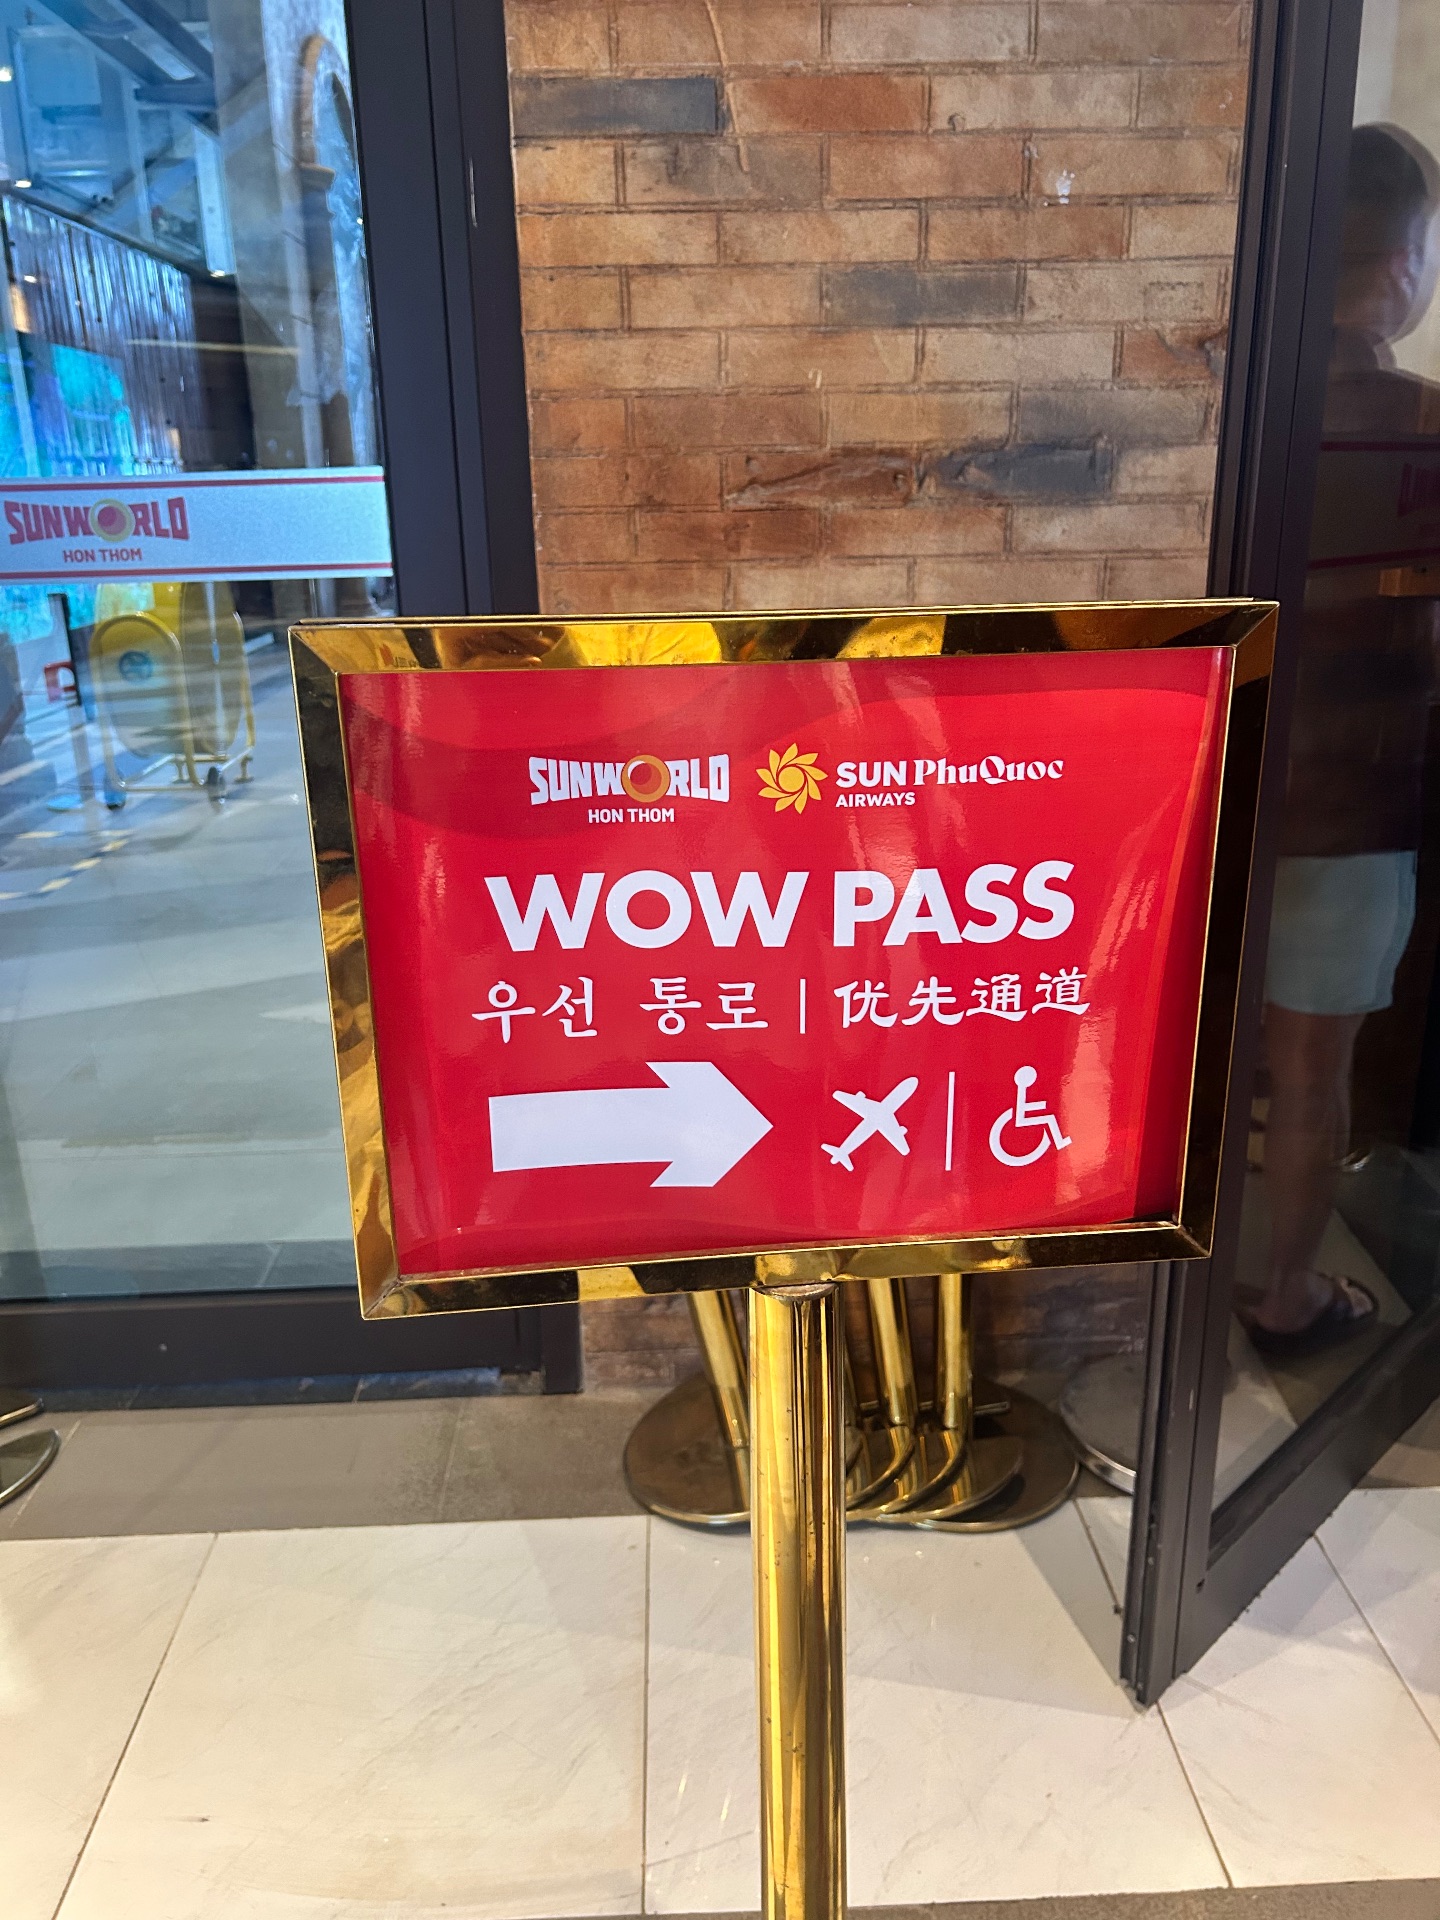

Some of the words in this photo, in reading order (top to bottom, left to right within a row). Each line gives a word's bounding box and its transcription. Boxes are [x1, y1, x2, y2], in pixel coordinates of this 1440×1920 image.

[4, 496, 190, 545] SUNWORLD
[63, 549, 96, 563] HON
[100, 547, 143, 563] THOM
[529, 754, 730, 805] SUNWORLD
[835, 760, 907, 788] SUN
[913, 755, 1064, 786] PhuQuoc
[588, 808, 624, 824] HON
[627, 807, 675, 823] THOM
[835, 791, 916, 808] AIRWAYS
[485, 869, 810, 952] WOW
[833, 860, 1075, 947] PASS
[472, 976, 598, 1044] 우선
[639, 976, 769, 1035] 통로
[833, 966, 1090, 1029] 优先通道
